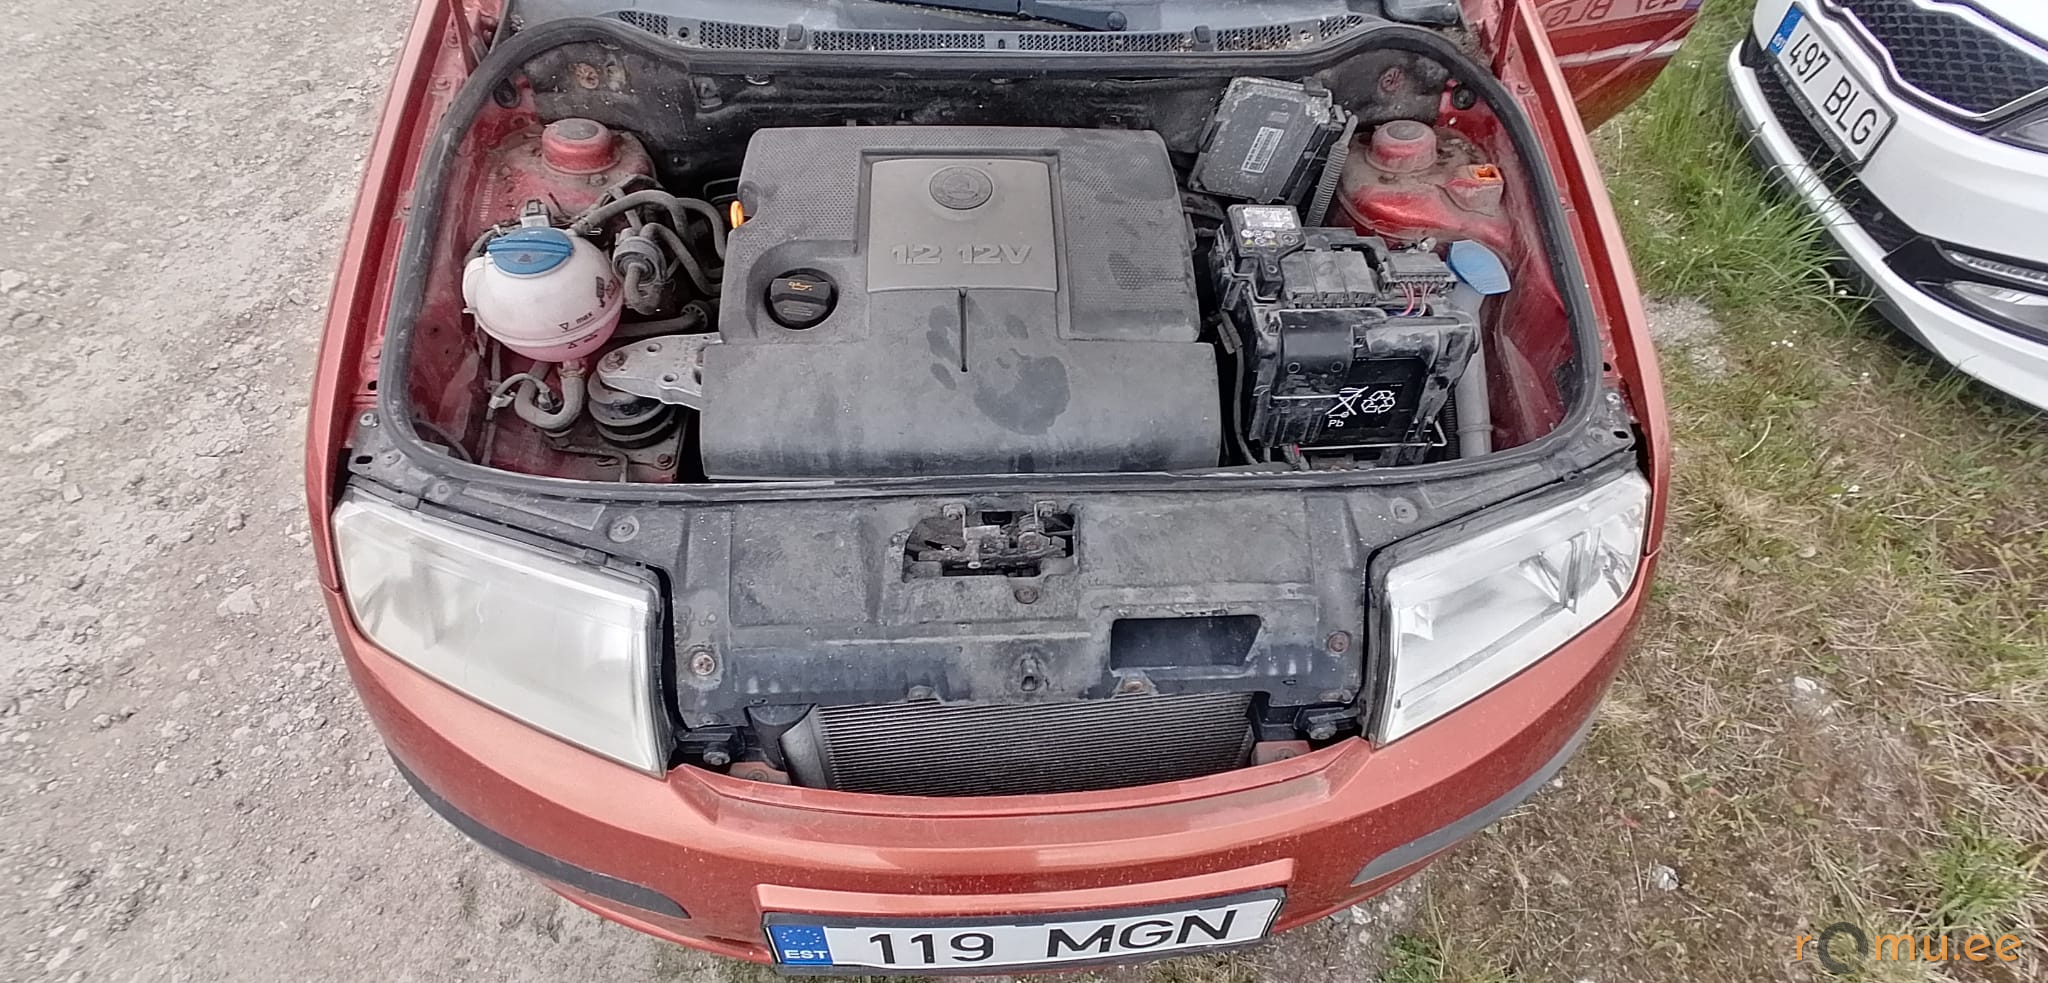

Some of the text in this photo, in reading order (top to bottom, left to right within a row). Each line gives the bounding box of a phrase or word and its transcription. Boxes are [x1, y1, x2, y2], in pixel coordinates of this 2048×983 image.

[1789, 33, 1831, 83] 497
[1822, 75, 1877, 145] BLG
[958, 243, 1033, 265] 12V
[1327, 419, 1345, 428] Pb
[784, 908, 1238, 965] EST 119 MGN
